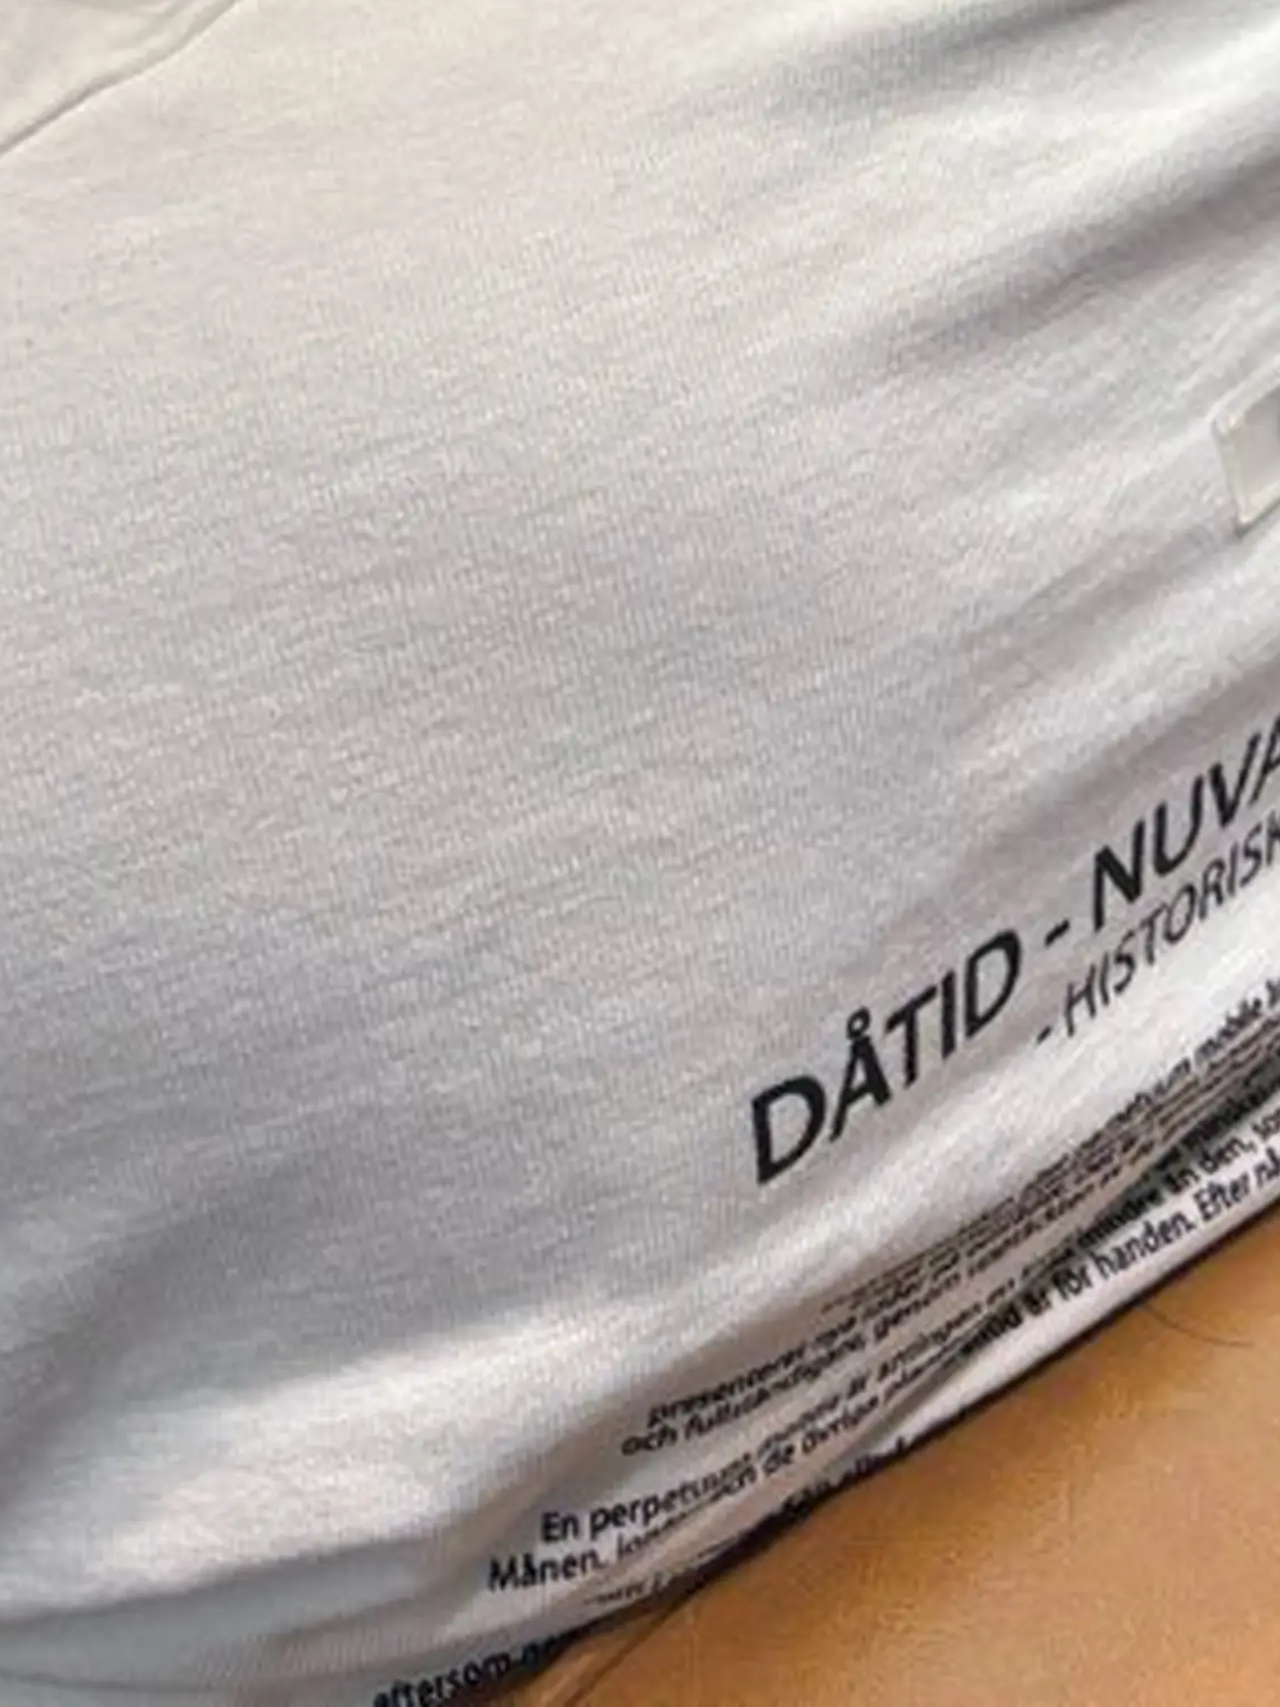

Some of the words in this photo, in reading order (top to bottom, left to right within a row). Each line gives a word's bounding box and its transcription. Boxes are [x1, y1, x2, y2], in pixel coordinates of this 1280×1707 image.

[750, 929, 1022, 1185] DÅTID
[1198, 1136, 1258, 1176] den,
[1087, 1210, 1198, 1281] handen.
[1193, 1171, 1251, 1223] Efter
[621, 1425, 679, 1456] och
[541, 1510, 580, 1542] En
